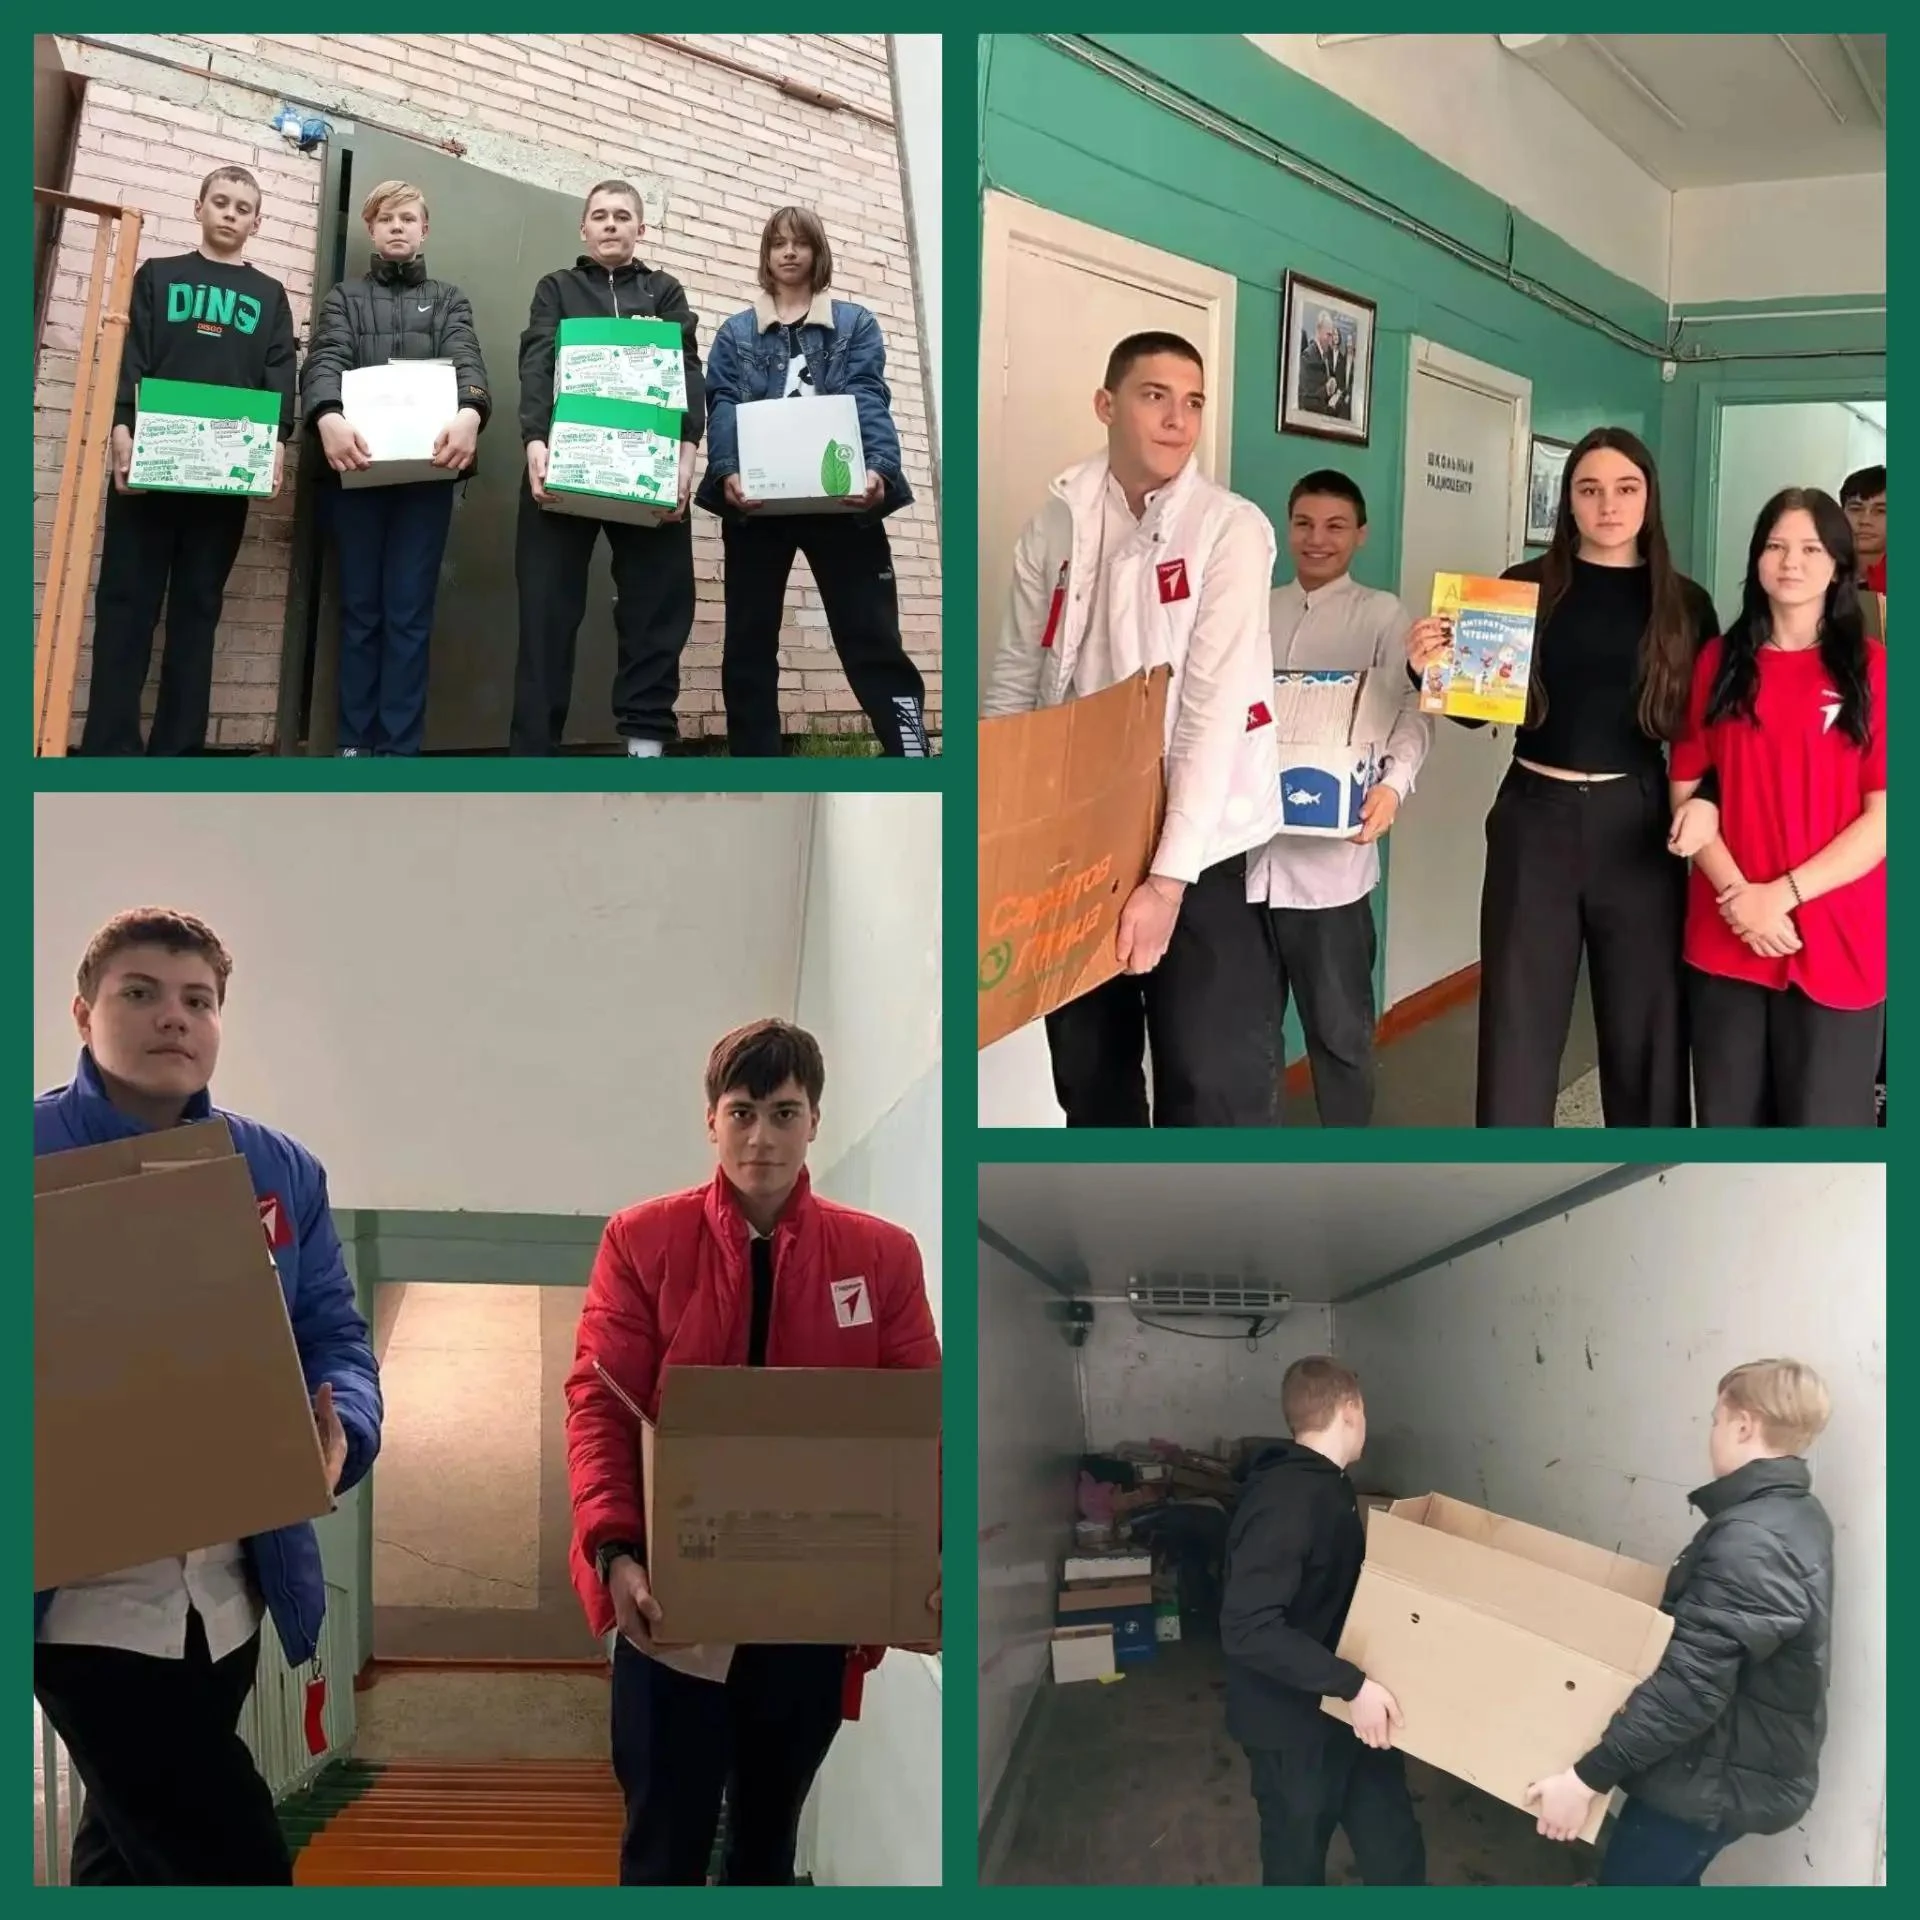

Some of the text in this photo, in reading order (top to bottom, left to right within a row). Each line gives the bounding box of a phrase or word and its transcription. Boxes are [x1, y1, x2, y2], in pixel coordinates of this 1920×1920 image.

[1427, 452, 1474, 475] ШКОЛЬНЫЙ
[1426, 473, 1473, 496] РАДИОЦЕНТР
[1462, 629, 1504, 643] ЧТЕНИЕ
